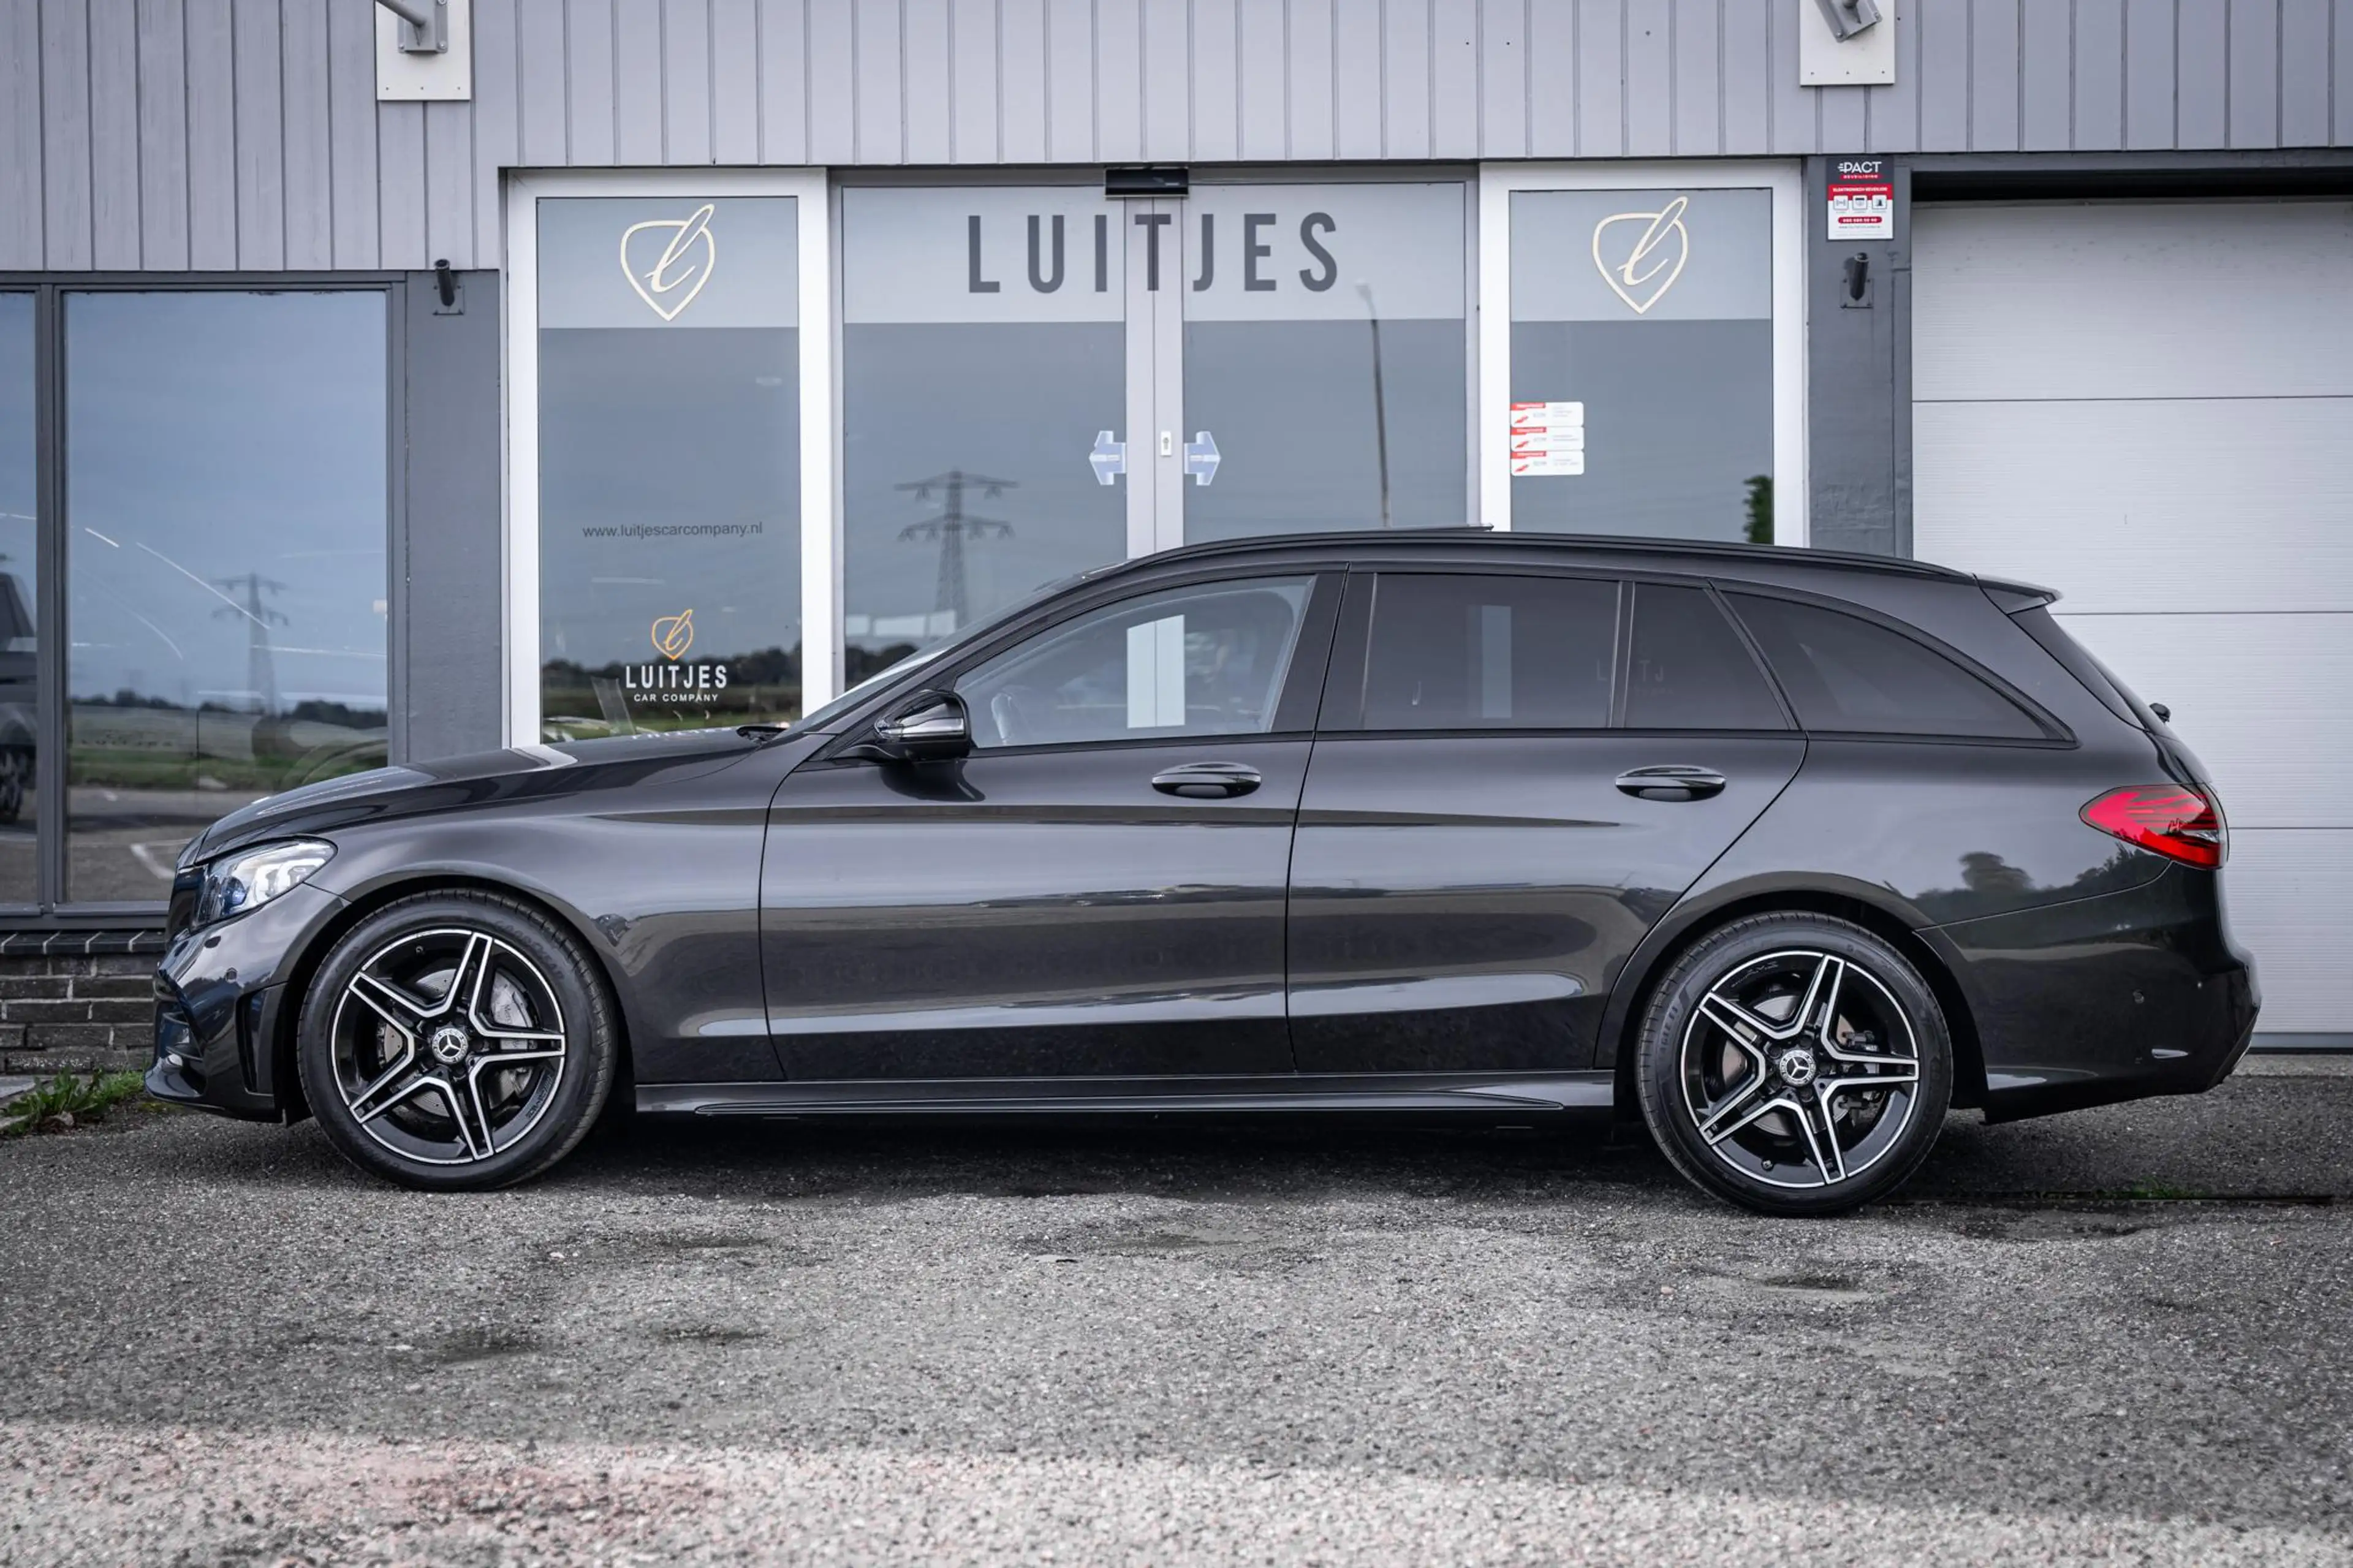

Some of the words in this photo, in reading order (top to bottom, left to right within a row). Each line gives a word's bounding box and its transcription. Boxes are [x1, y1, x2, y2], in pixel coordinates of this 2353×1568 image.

[1839, 161, 1882, 173] PACT
[968, 212, 1338, 293] LUITJES
[582, 521, 763, 540] www.luitjescarcompany.nl
[626, 665, 727, 689] LUITJES
[662, 693, 719, 702] COMPANY
